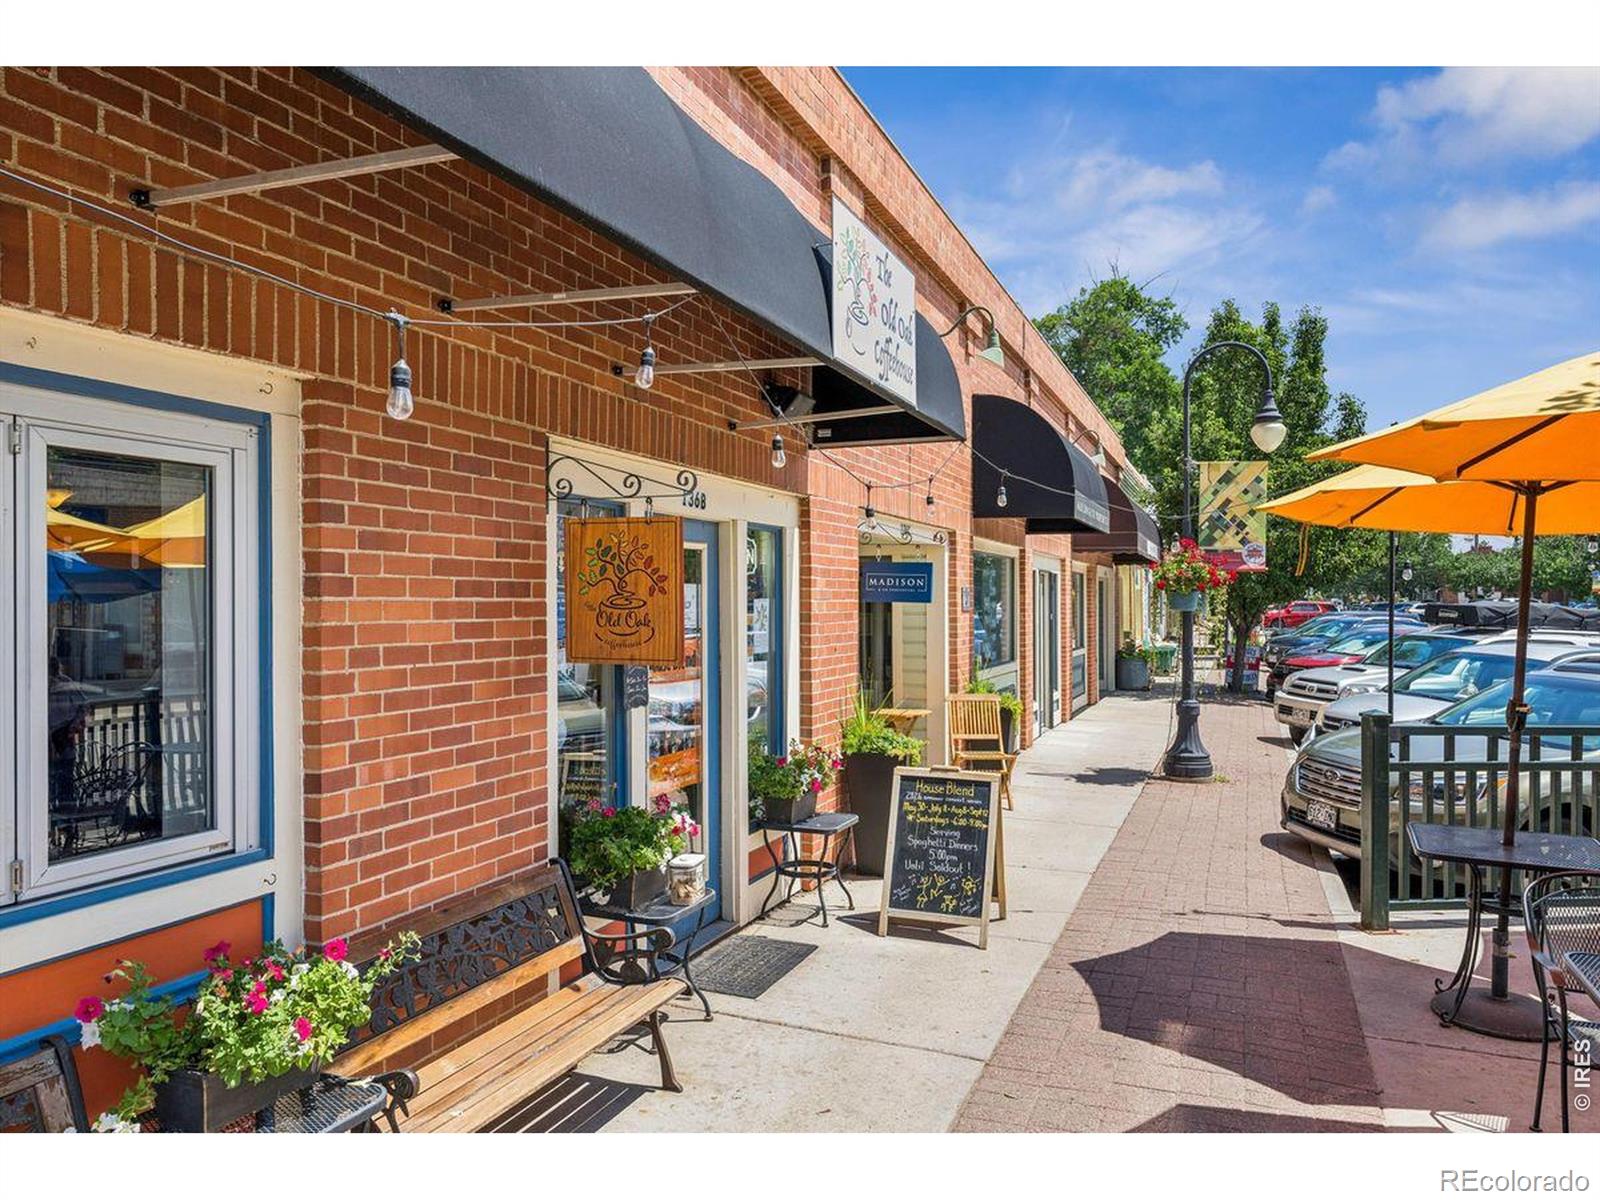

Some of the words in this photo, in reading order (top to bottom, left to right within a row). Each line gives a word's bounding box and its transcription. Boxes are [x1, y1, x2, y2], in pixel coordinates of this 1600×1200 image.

[876, 252, 893, 288] The
[881, 297, 898, 334] Old
[898, 315, 914, 346] Oak
[868, 577, 925, 587] MADISON
[596, 610, 621, 628] Old
[625, 610, 651, 629] Oak
[916, 779, 945, 794] House
[946, 780, 975, 797] Blend
[929, 826, 961, 840] Serving
[907, 834, 946, 849] Spaghetti
[948, 839, 978, 852] Dinners
